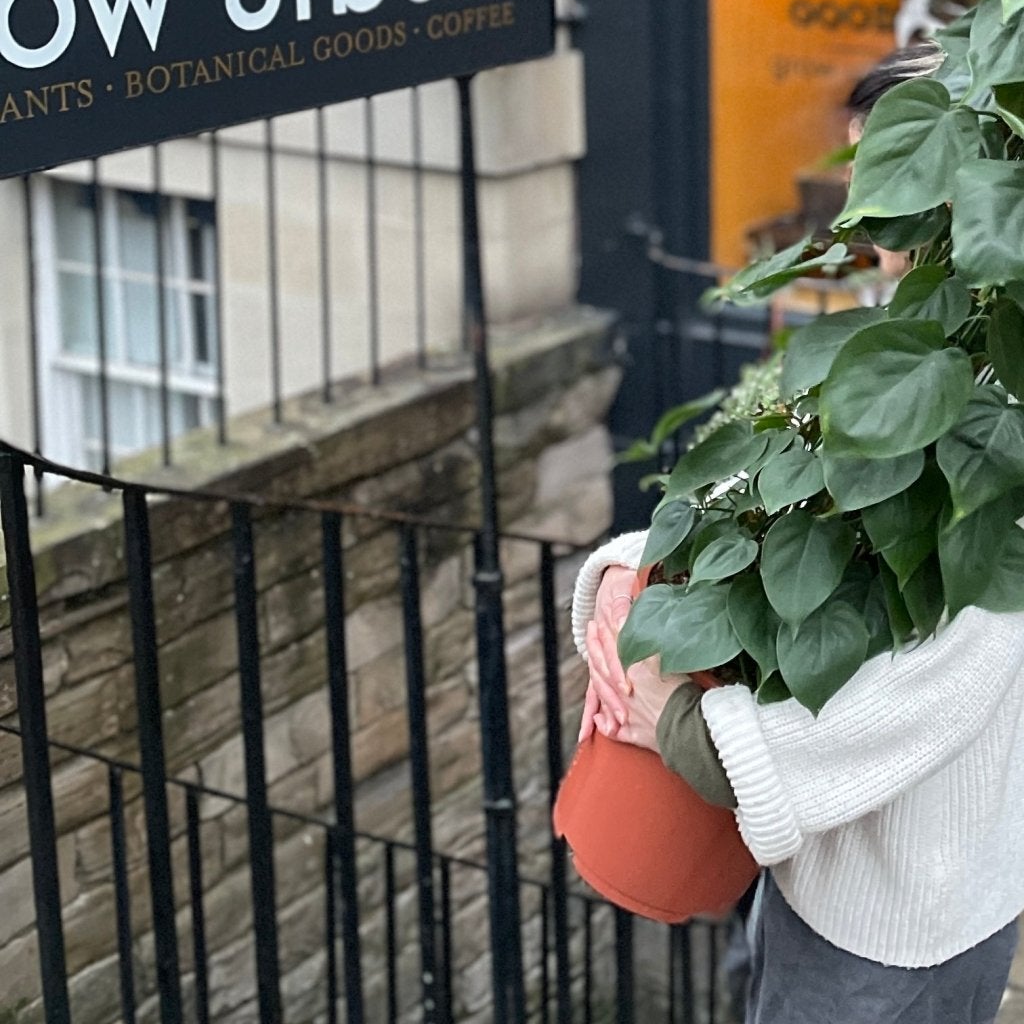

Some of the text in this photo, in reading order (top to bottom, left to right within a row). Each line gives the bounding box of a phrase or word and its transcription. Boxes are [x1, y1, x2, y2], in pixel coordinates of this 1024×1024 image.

[125, 41, 305, 99] BOTANICAL
[313, 21, 407, 61] GOODS
[426, 2, 516, 40] COFFEE
